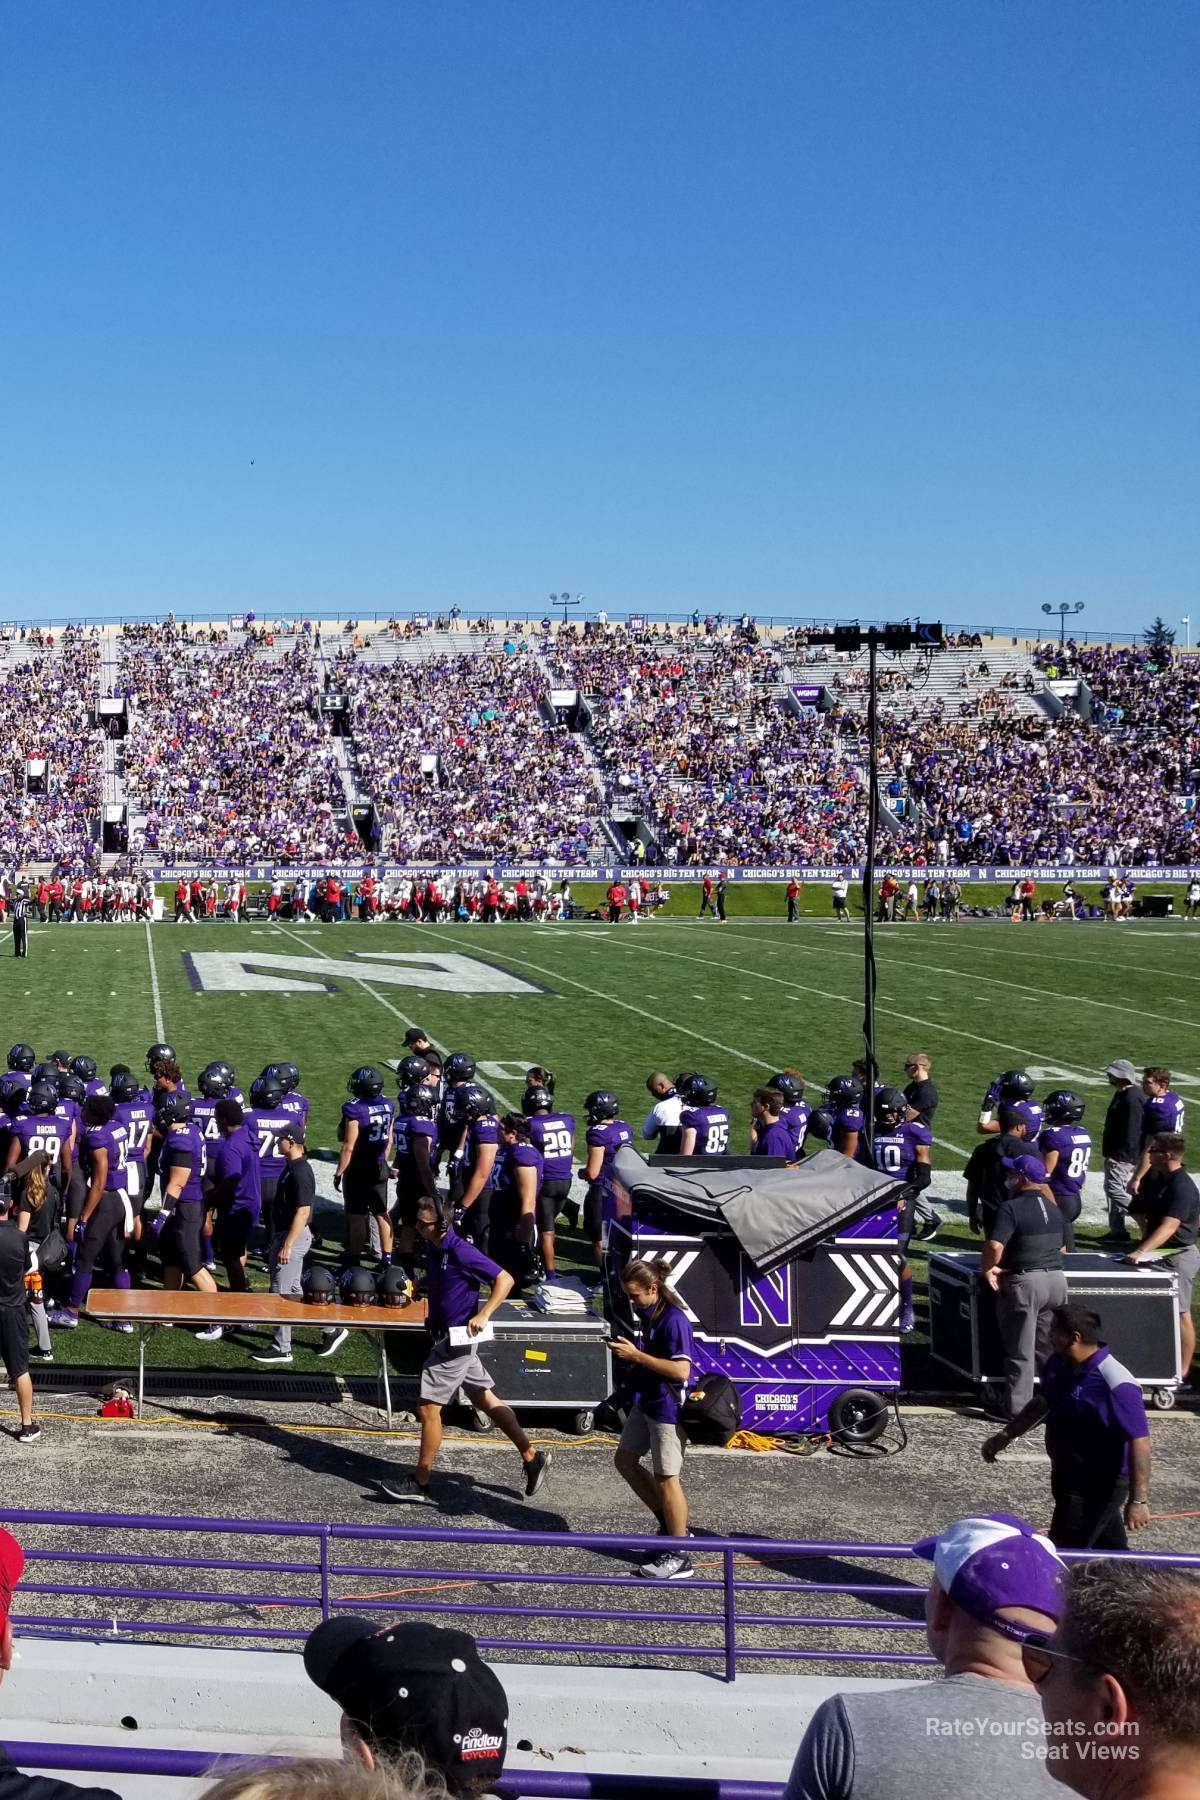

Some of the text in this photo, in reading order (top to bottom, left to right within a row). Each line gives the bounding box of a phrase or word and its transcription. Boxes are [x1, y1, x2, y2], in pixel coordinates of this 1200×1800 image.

[200, 869, 212, 878] BIG
[213, 869, 228, 878] TEN
[310, 869, 323, 877] BIG
[345, 869, 363, 877] TEAM
[440, 869, 456, 877] TEN
[457, 869, 479, 877] TEAM
[501, 869, 541, 877] CHICAGO'S
[543, 869, 556, 877] BIG
[558, 869, 575, 877] TEN
[576, 869, 598, 877] TEAM
[621, 869, 662, 877] CHICAGO'S
[663, 869, 677, 877] BIG
[678, 869, 695, 877] TEN
[742, 869, 785, 878] CHICAGO'S
[786, 869, 800, 878] BIG
[802, 869, 818, 878] TEN
[911, 869, 926, 877] BIG
[927, 869, 945, 877] TEN
[947, 869, 970, 877] TEAM
[994, 869, 1039, 877] CHICAGO'S
[1040, 869, 1054, 877] BIG
[1056, 869, 1074, 877] TEN
[1075, 869, 1100, 877] TEAM
[1172, 869, 1188, 878] BIG
[369, 1115, 390, 1141] 33
[128, 1120, 150, 1148] 17
[706, 1125, 728, 1153] 85
[543, 1131, 572, 1158] 29
[874, 1145, 901, 1171] 10
[739, 1251, 791, 1326] N
[755, 1394, 798, 1404] CHICAGO'S
[780, 1404, 797, 1412] TEAM
[462, 1749, 499, 1760] TOYOTA
